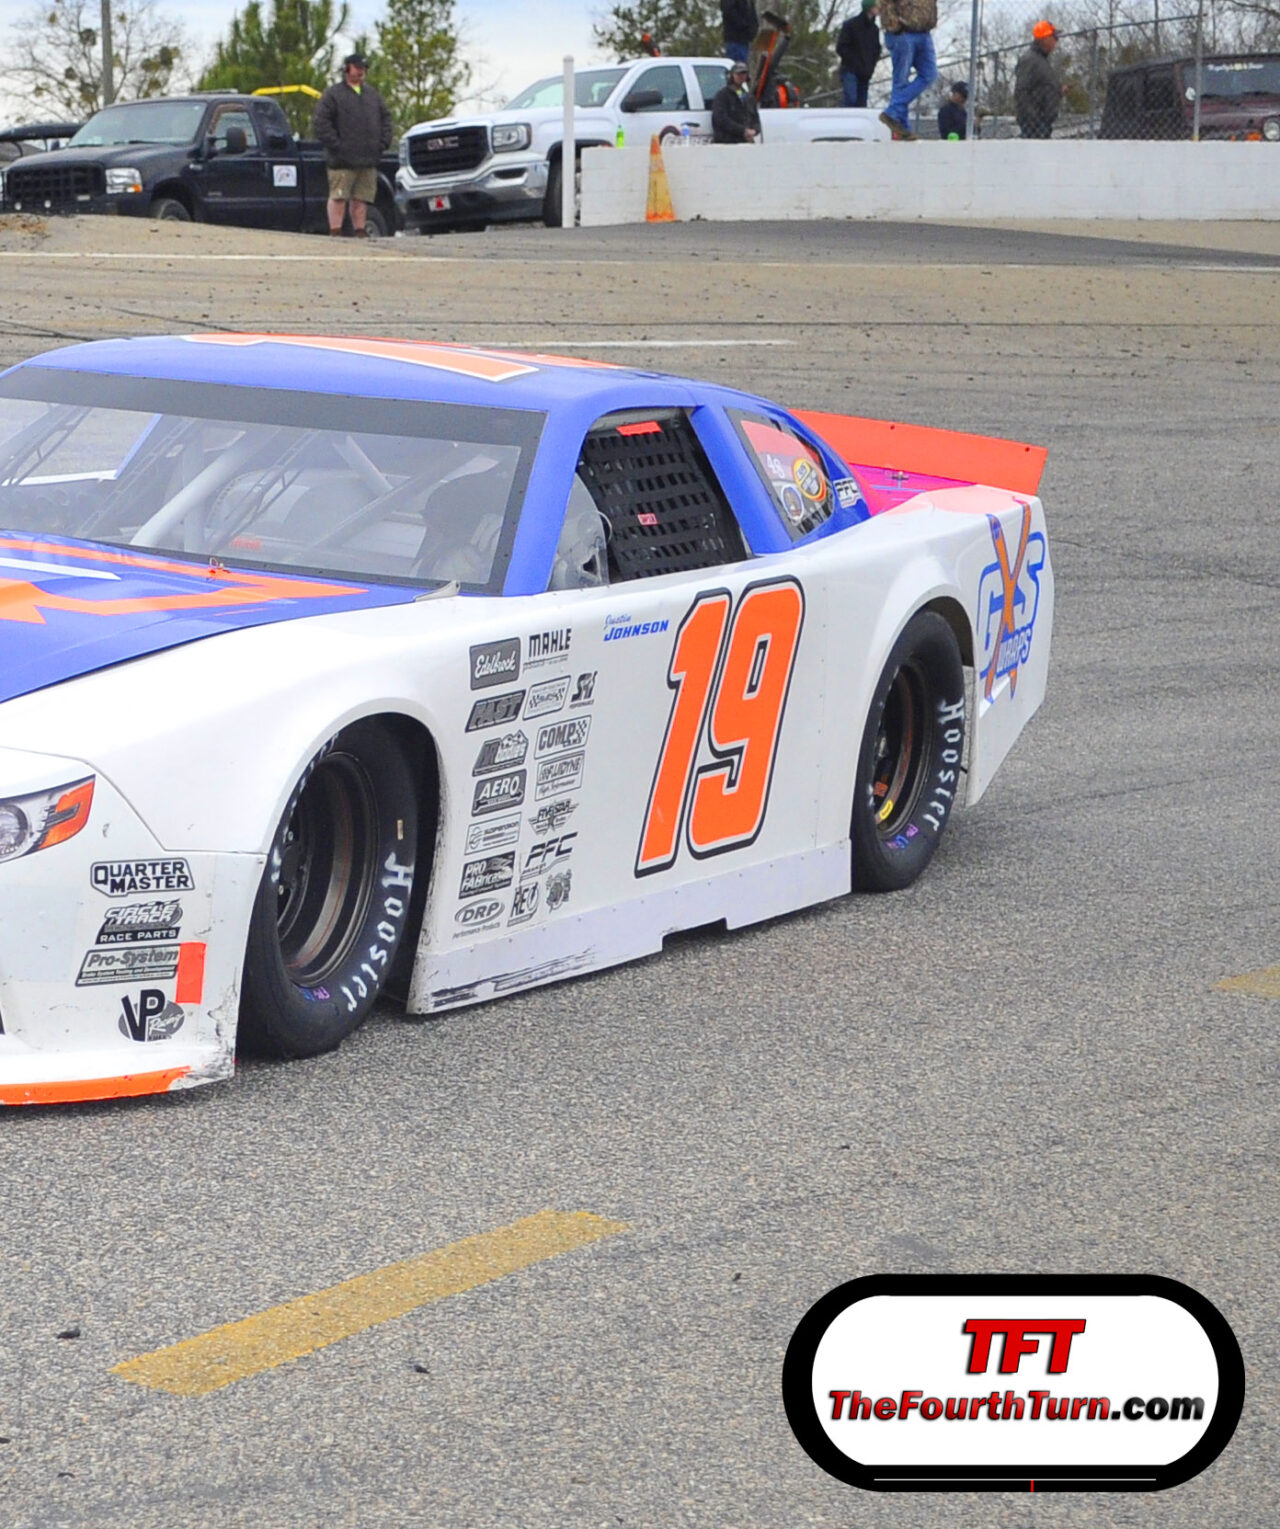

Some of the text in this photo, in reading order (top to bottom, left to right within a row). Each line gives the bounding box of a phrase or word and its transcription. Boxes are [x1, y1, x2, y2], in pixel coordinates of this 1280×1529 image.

[603, 619, 669, 642] JOHNSON
[528, 628, 572, 658] MAHLE
[475, 650, 516, 679] Edelbrock
[539, 722, 577, 751] COMP
[634, 574, 806, 879] 19
[478, 775, 521, 800] AERO
[525, 832, 578, 868] PFC
[94, 861, 185, 885] QUARTER
[465, 860, 488, 880] PRO
[110, 875, 190, 893] MASTER
[105, 902, 180, 918] CIRCLE
[109, 912, 173, 925] TRACK
[461, 901, 500, 923] DRP
[100, 929, 177, 943] RACE PARTS
[121, 989, 166, 1042] VP
